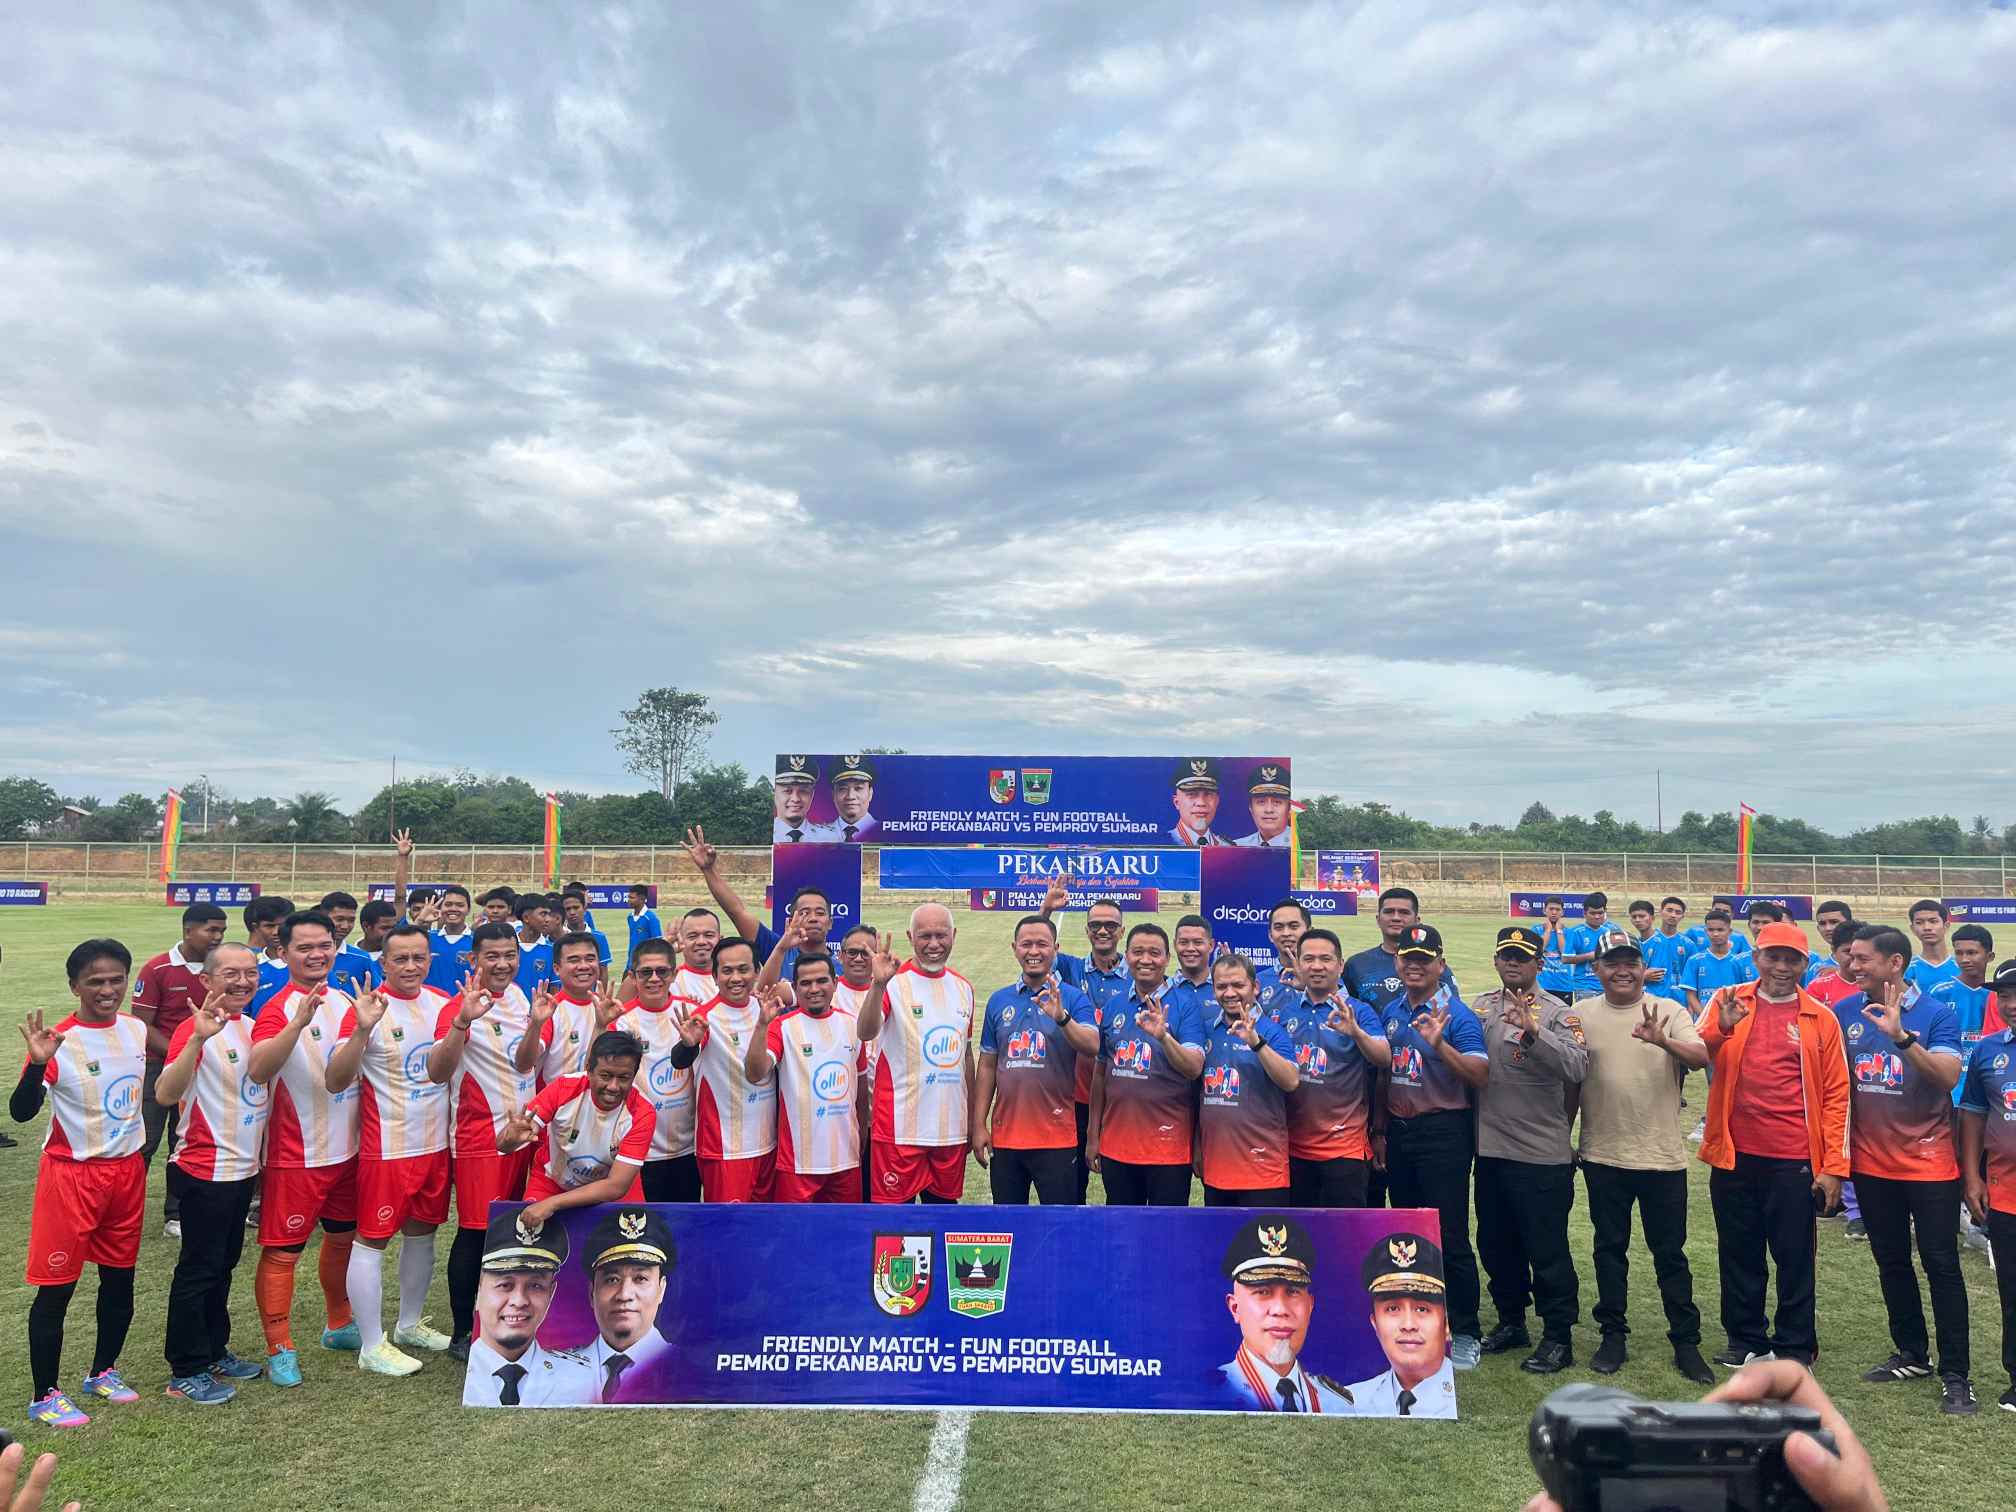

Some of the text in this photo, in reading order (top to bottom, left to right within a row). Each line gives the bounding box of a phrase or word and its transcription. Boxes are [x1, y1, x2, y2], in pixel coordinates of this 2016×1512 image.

[910, 811, 972, 821] FRIENDLY
[976, 811, 1020, 822] MATCH
[1033, 811, 1059, 822] FUN
[1063, 812, 1130, 822] FOOTBALL
[882, 821, 1158, 833] PEMKO PEKANBARU VS PEMPROV SUMBAR
[997, 854, 1159, 875] PEKANBARU
[1008, 892, 1036, 900] PIALA
[1066, 892, 1085, 900] OTA
[1087, 892, 1141, 901] PEKANBARU
[1252, 947, 1271, 957] KOTA
[947, 1235, 1010, 1244] SUMATERA BARAT
[762, 1336, 863, 1353] FRIENDLY
[869, 1336, 939, 1354] MATCH
[960, 1337, 1002, 1354] FUN
[1008, 1338, 1117, 1357] FOOTBALL
[716, 1354, 1161, 1376] PEMKO PEKANBARU VS PEMPROV SUMBAR
